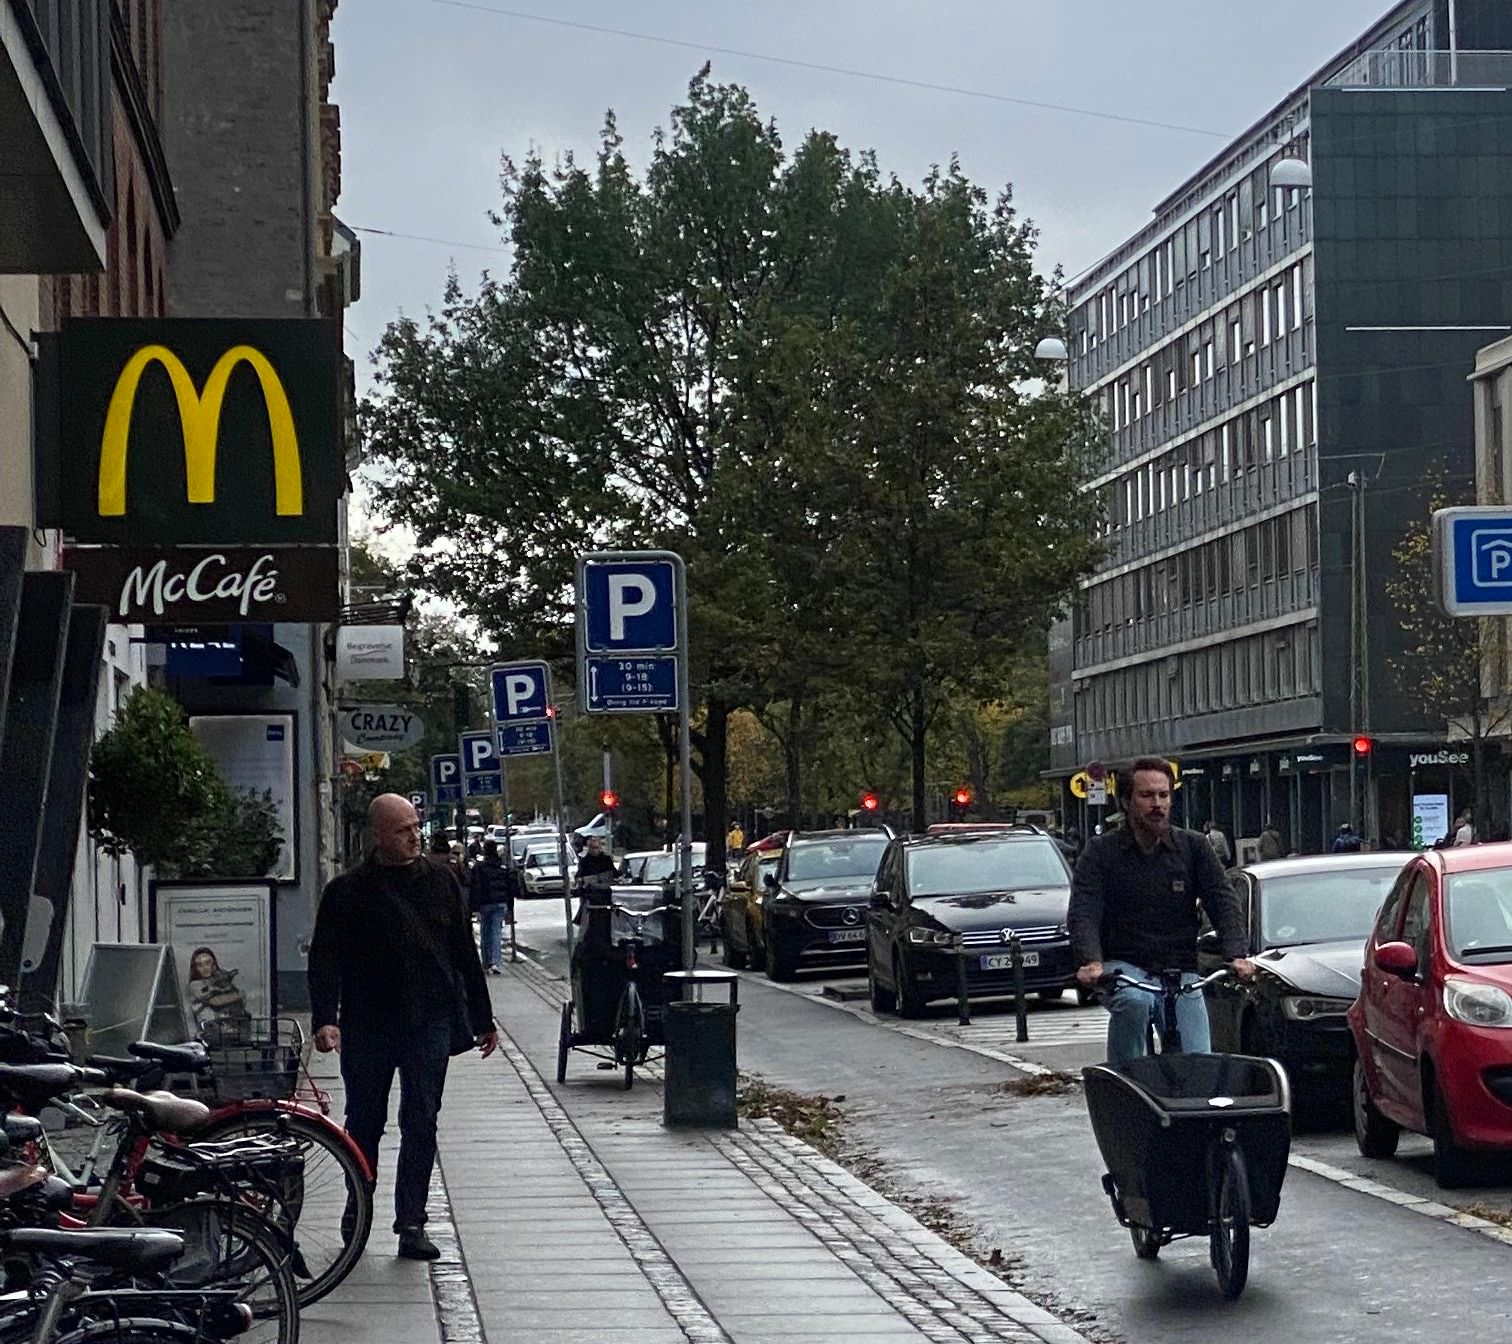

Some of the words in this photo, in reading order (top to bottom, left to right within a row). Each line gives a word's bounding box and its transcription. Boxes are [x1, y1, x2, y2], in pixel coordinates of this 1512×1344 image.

[119, 554, 280, 616] McCafé
[608, 573, 656, 640] P
[505, 674, 536, 715] P
[351, 713, 413, 734] CRAZY
[471, 739, 492, 769] P
[1409, 750, 1469, 768] youSee
[440, 761, 457, 783] P
